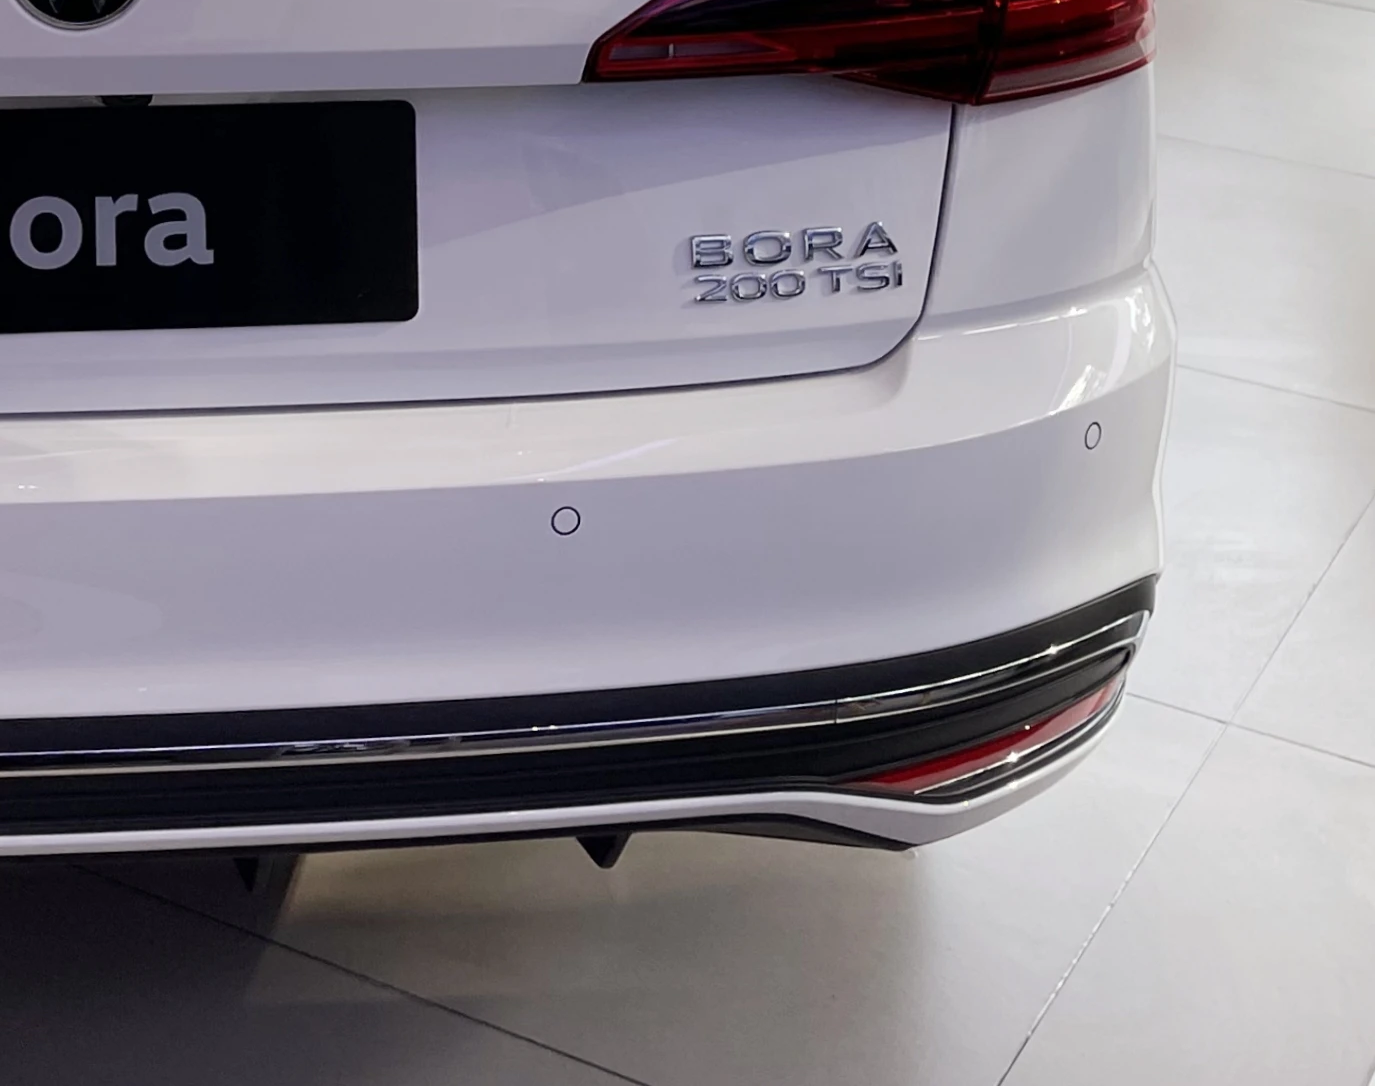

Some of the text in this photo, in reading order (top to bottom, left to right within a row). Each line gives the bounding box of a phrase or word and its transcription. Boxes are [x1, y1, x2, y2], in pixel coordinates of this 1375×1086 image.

[690, 220, 899, 268] BORA
[694, 259, 904, 303] 200 TSI
